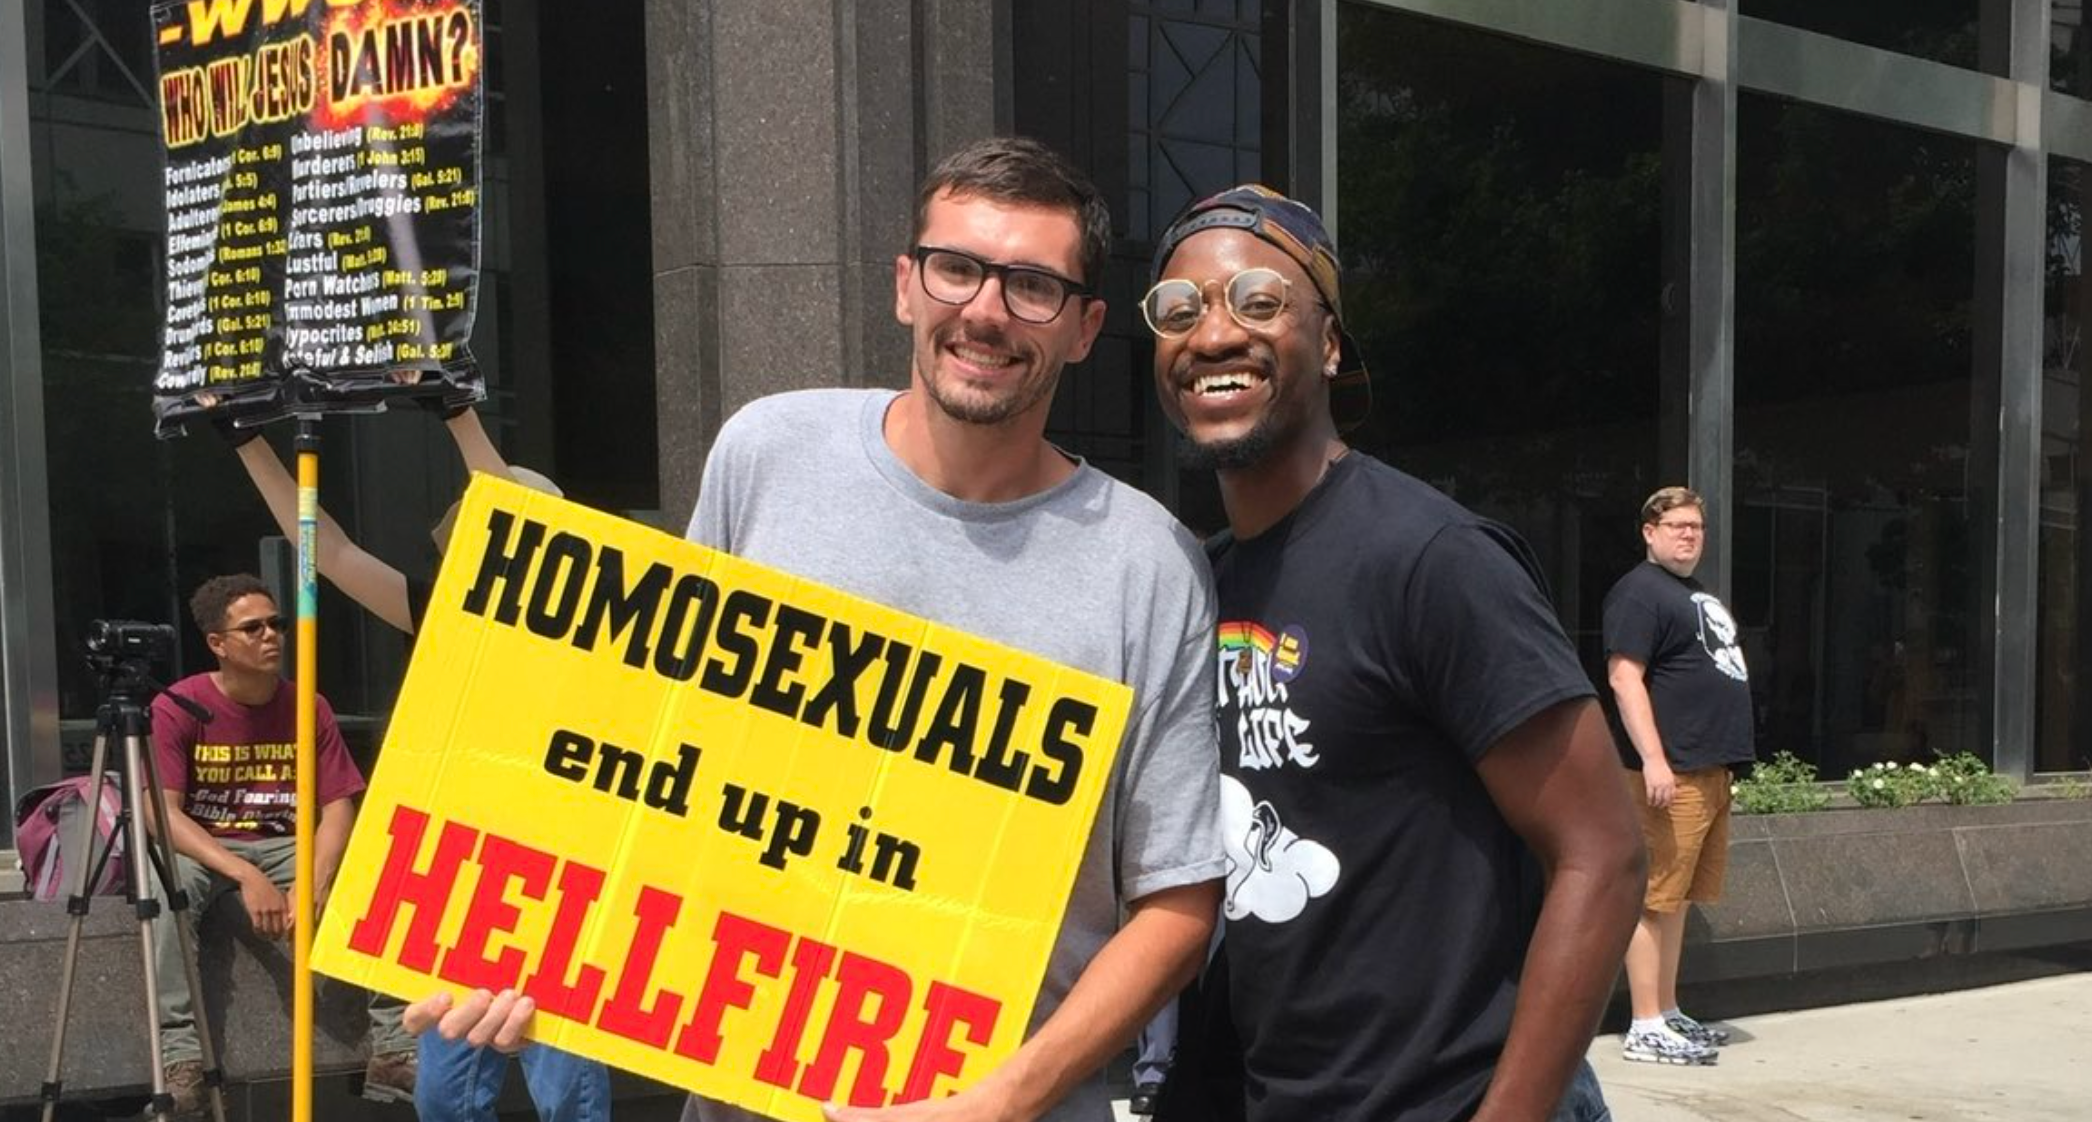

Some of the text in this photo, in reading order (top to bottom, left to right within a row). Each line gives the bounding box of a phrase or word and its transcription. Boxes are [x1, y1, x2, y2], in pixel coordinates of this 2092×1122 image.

[161, 65, 208, 148] WHO
[250, 32, 316, 124] JESUS
[328, 9, 472, 107] DAMN?
[366, 126, 397, 144] (Rev.
[238, 148, 260, 164] Cor.
[367, 150, 398, 166] John
[437, 167, 462, 185] 5:21)
[424, 195, 449, 215] (Rev.
[221, 222, 231, 240] (1
[235, 221, 257, 236] Cor.
[219, 246, 262, 264] (Romans
[285, 250, 338, 275] Lustful
[284, 279, 316, 299] Porn
[221, 294, 244, 309] Cor.
[403, 294, 415, 313] (1
[217, 317, 243, 335] (Gal.
[244, 313, 271, 331] 5:21)
[214, 341, 238, 357] Cor.
[339, 345, 351, 366] &
[397, 342, 425, 362] (Gal.
[463, 508, 1098, 807] HOMOSEXUALS
[1238, 707, 1320, 770] LIFE
[235, 745, 251, 762] IS
[254, 743, 297, 762] WHA
[196, 766, 232, 783] YOU
[235, 764, 276, 782] CALL
[544, 728, 922, 891] end up in
[348, 804, 1003, 1107] HELLFIRE
